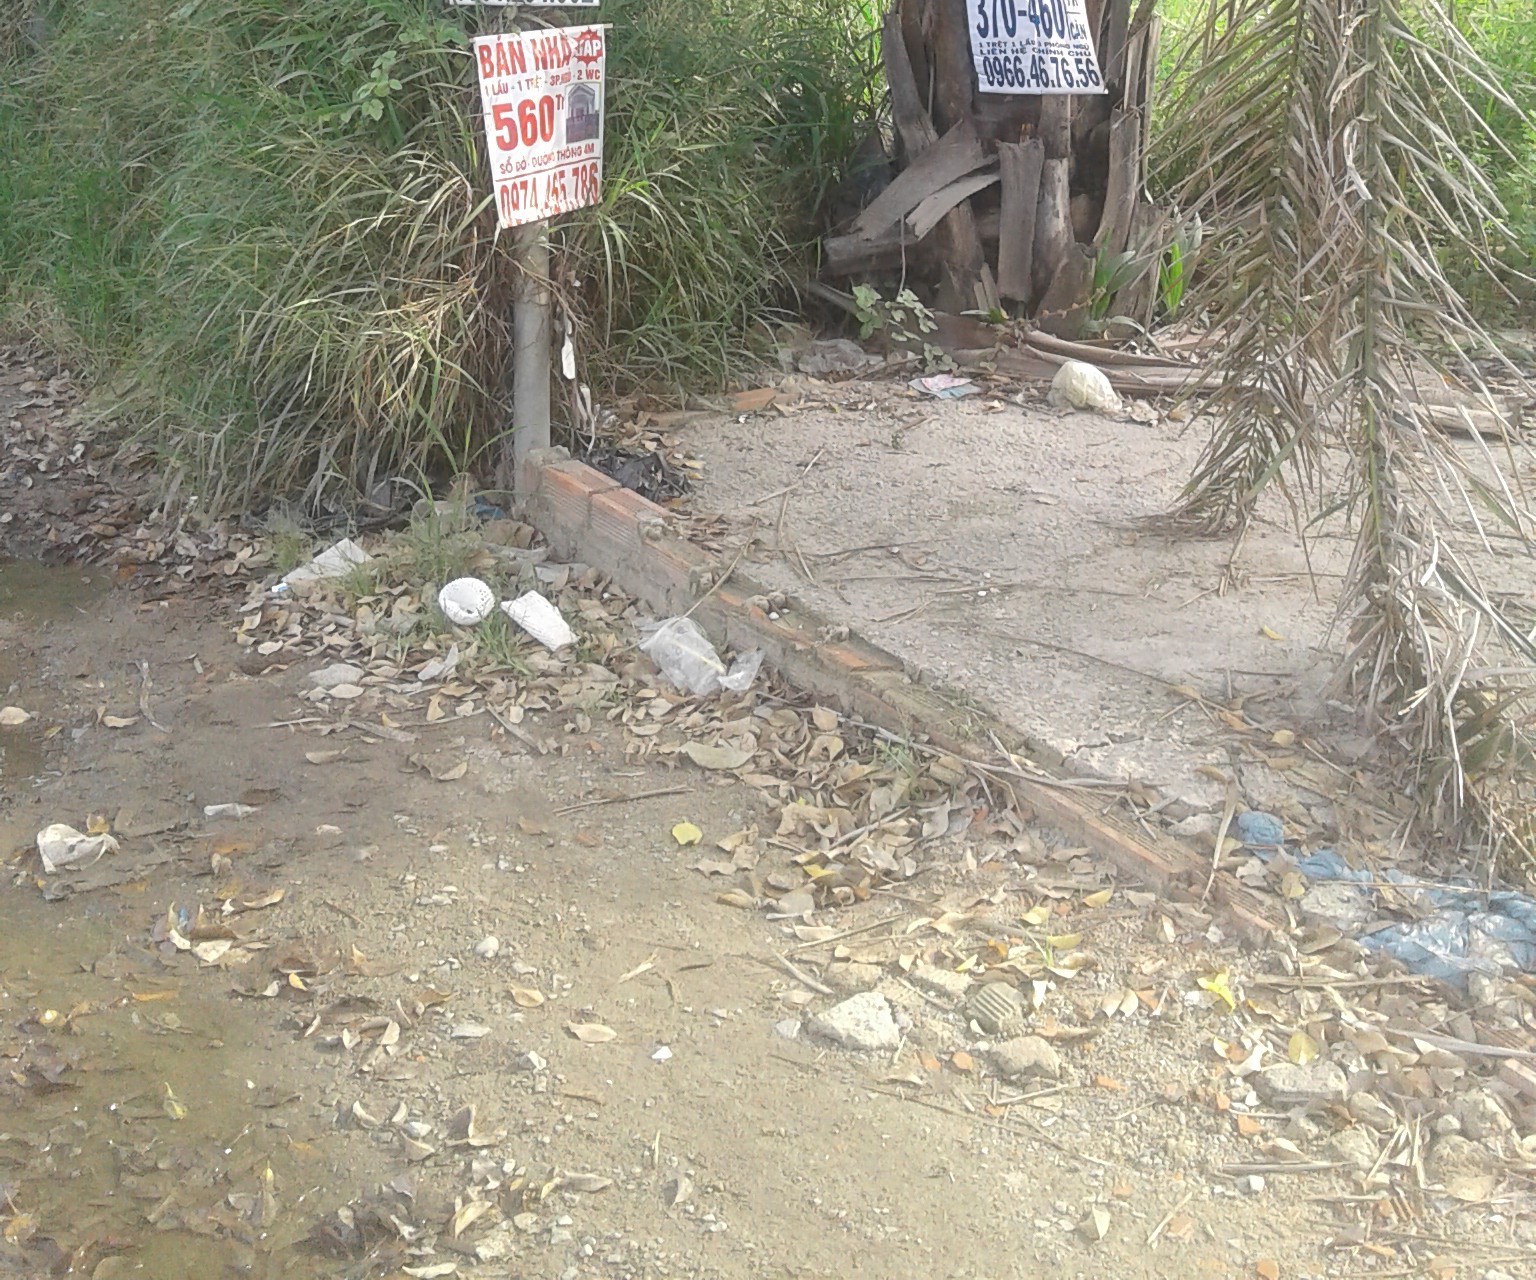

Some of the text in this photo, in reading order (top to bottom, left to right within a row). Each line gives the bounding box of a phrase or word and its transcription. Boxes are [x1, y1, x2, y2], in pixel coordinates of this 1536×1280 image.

[479, 34, 527, 79] BÁN
[983, 54, 1100, 88] 0966.46.76.56
[586, 69, 600, 80] WC
